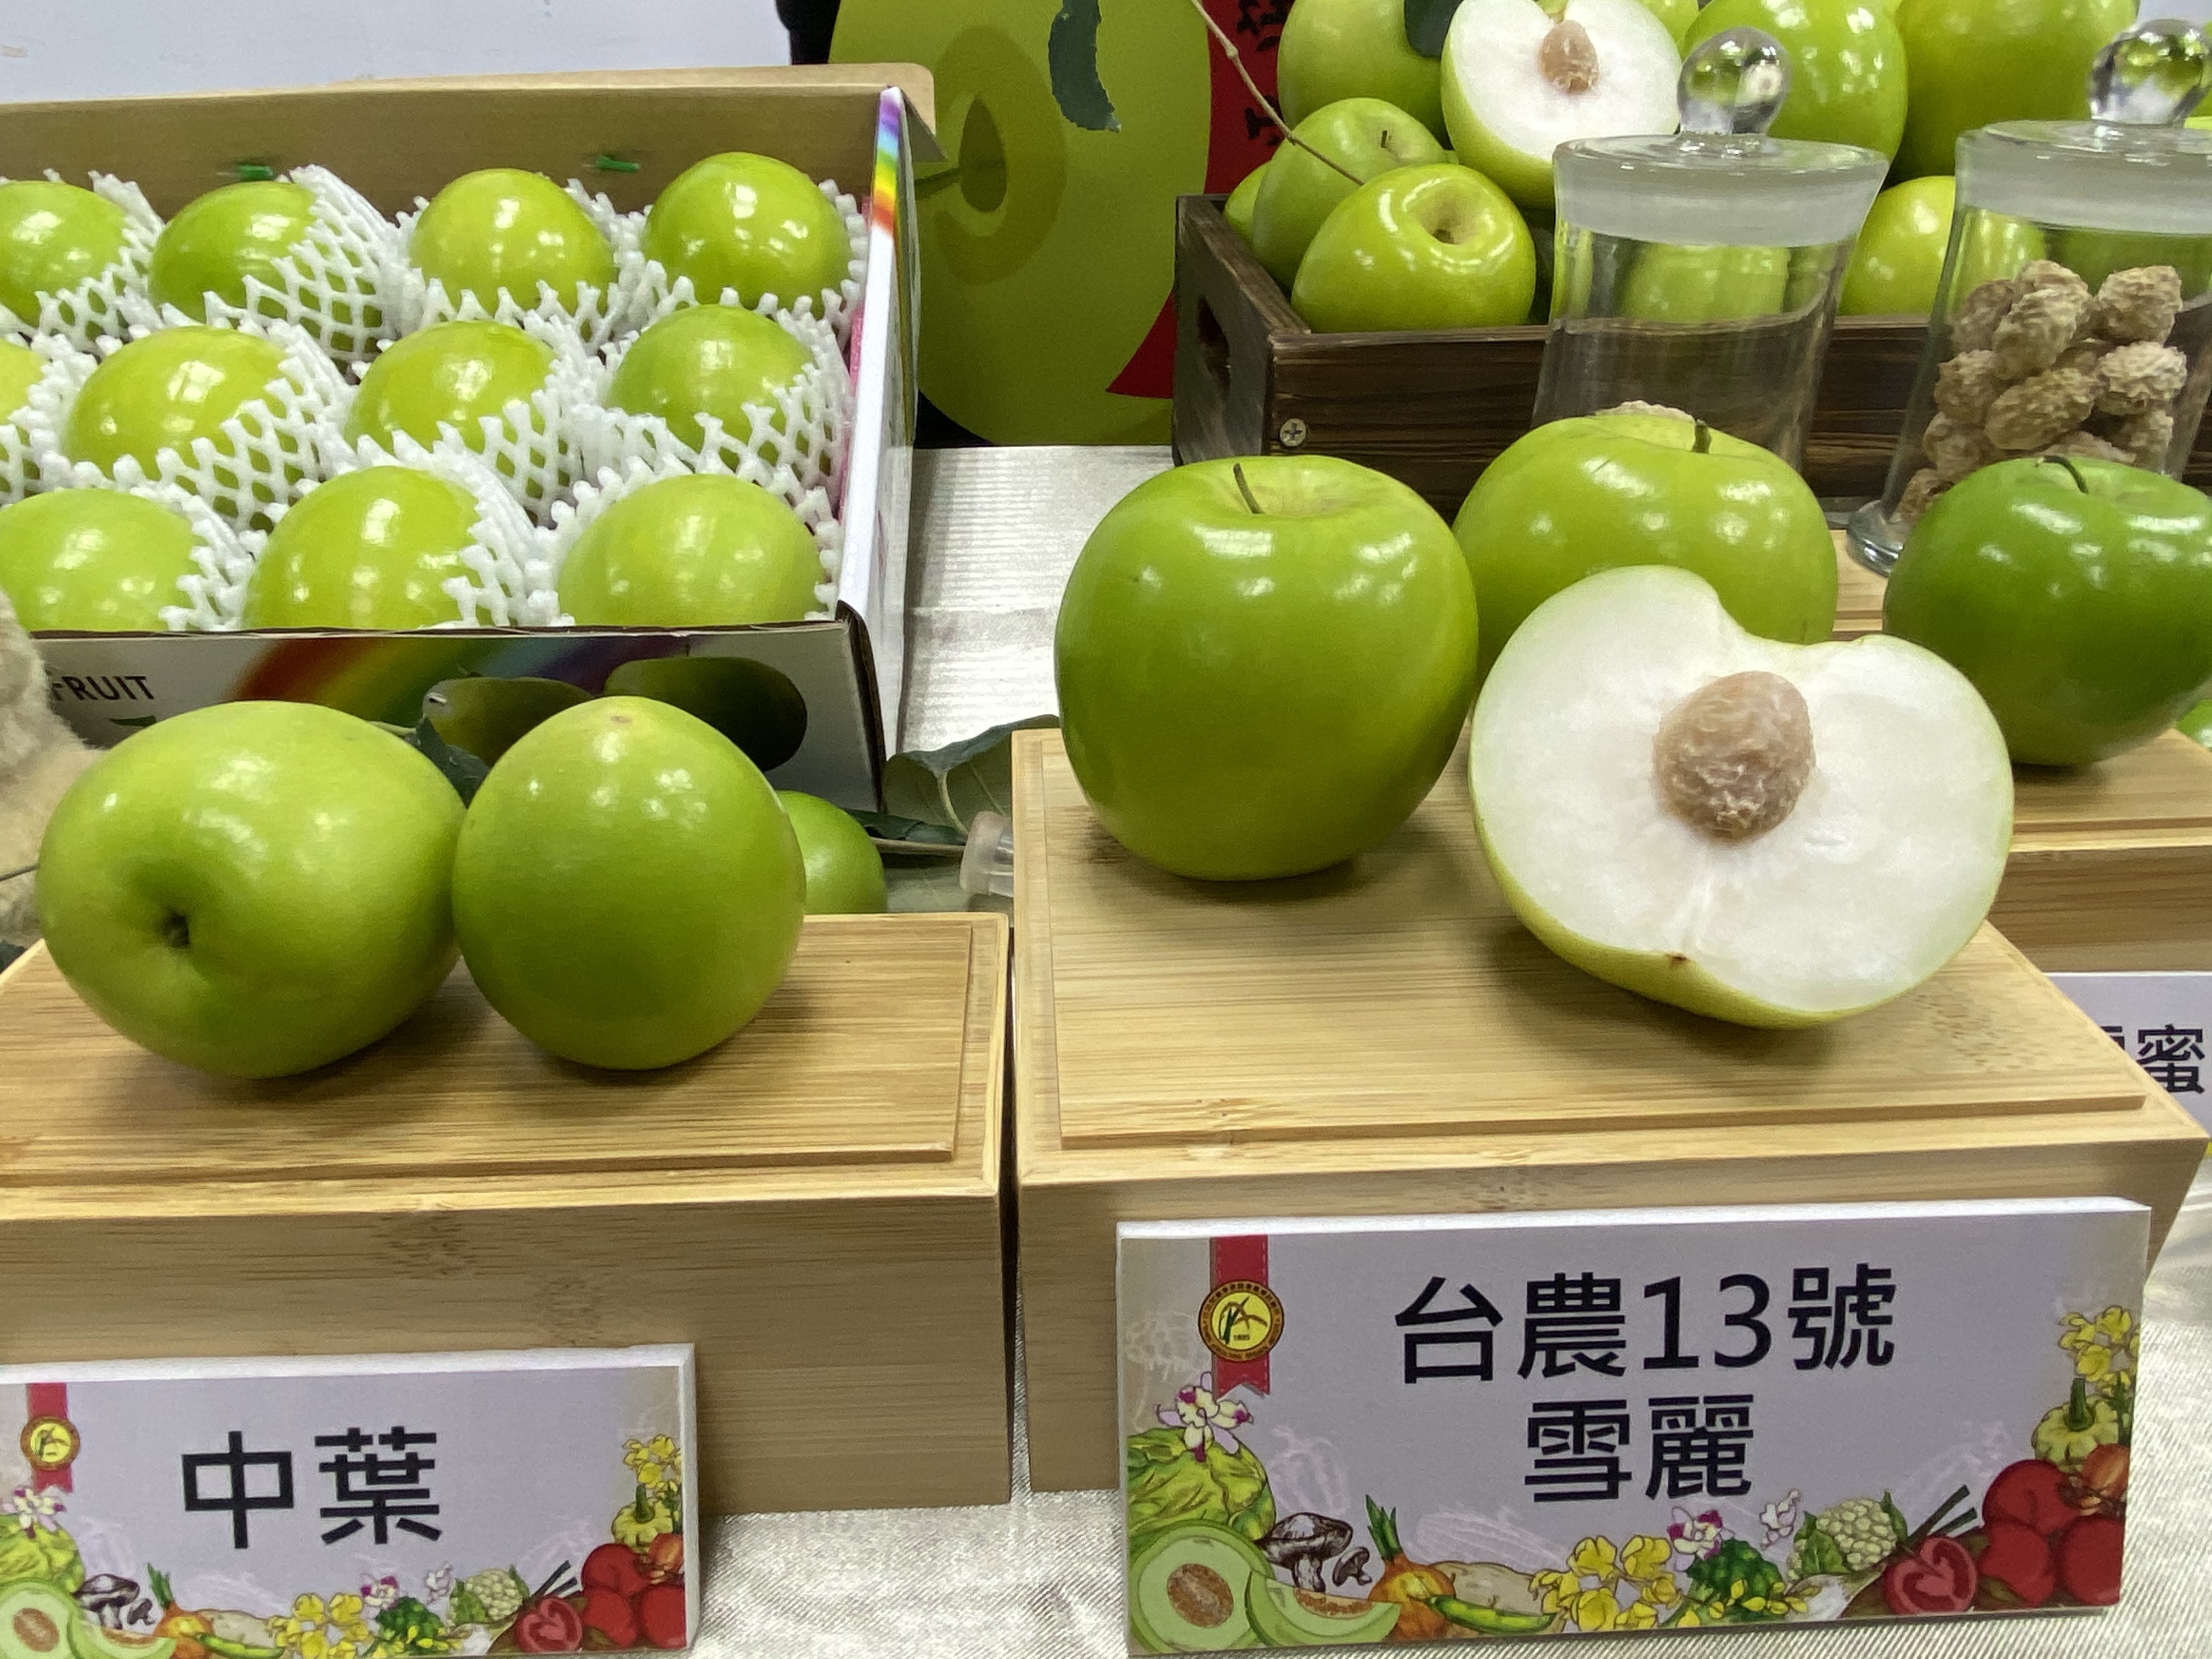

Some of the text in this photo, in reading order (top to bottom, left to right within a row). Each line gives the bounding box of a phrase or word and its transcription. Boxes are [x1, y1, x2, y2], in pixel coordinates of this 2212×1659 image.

[2101, 1024, 2205, 1094] 蜜
[1394, 1262, 1897, 1385] 台農13號
[181, 1426, 443, 1549] 中葉
[1524, 1393, 1754, 1503] 雪麗
